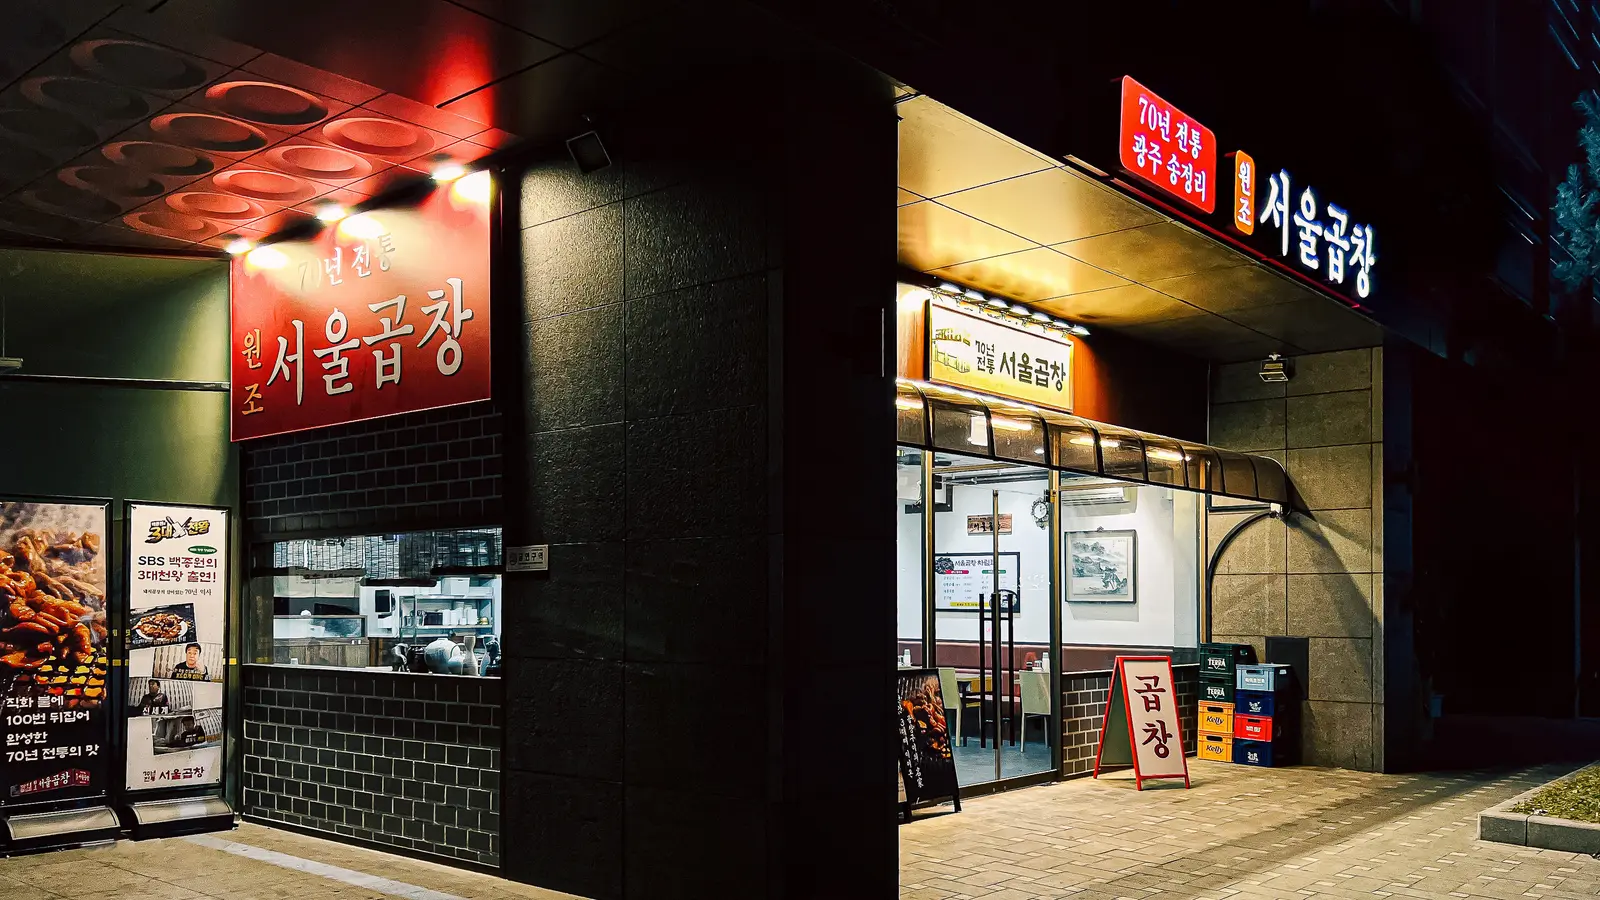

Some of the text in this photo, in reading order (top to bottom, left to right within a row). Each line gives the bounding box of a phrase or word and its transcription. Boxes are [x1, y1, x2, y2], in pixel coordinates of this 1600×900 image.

[1138, 96, 1203, 160] 70년 전통
[1132, 134, 1207, 203] 광주 송정리
[1237, 161, 1252, 226] 원조
[1259, 168, 1375, 298] 서울곱창
[351, 232, 396, 278] 전통
[266, 276, 474, 406] 서울곱창
[974, 339, 996, 358] 70년
[241, 328, 264, 416] 원조
[976, 356, 996, 375] 전통
[999, 351, 1067, 392] 서울곱창
[138, 556, 217, 569] SBS 백종원의
[138, 570, 216, 583] 3대천왕 출연!
[1207, 658, 1226, 667] TERRA
[1206, 687, 1225, 696] TERRA
[6, 697, 34, 709] 직화
[6, 710, 90, 726] 100번 뒤집어
[1133, 675, 1173, 759] 곱창
[1206, 715, 1224, 726] Kelly
[6, 731, 48, 746] 완성한
[6, 743, 99, 762] 70년 전통의 맛
[1205, 744, 1224, 755] Kelly
[159, 766, 205, 781] 서울곱창
